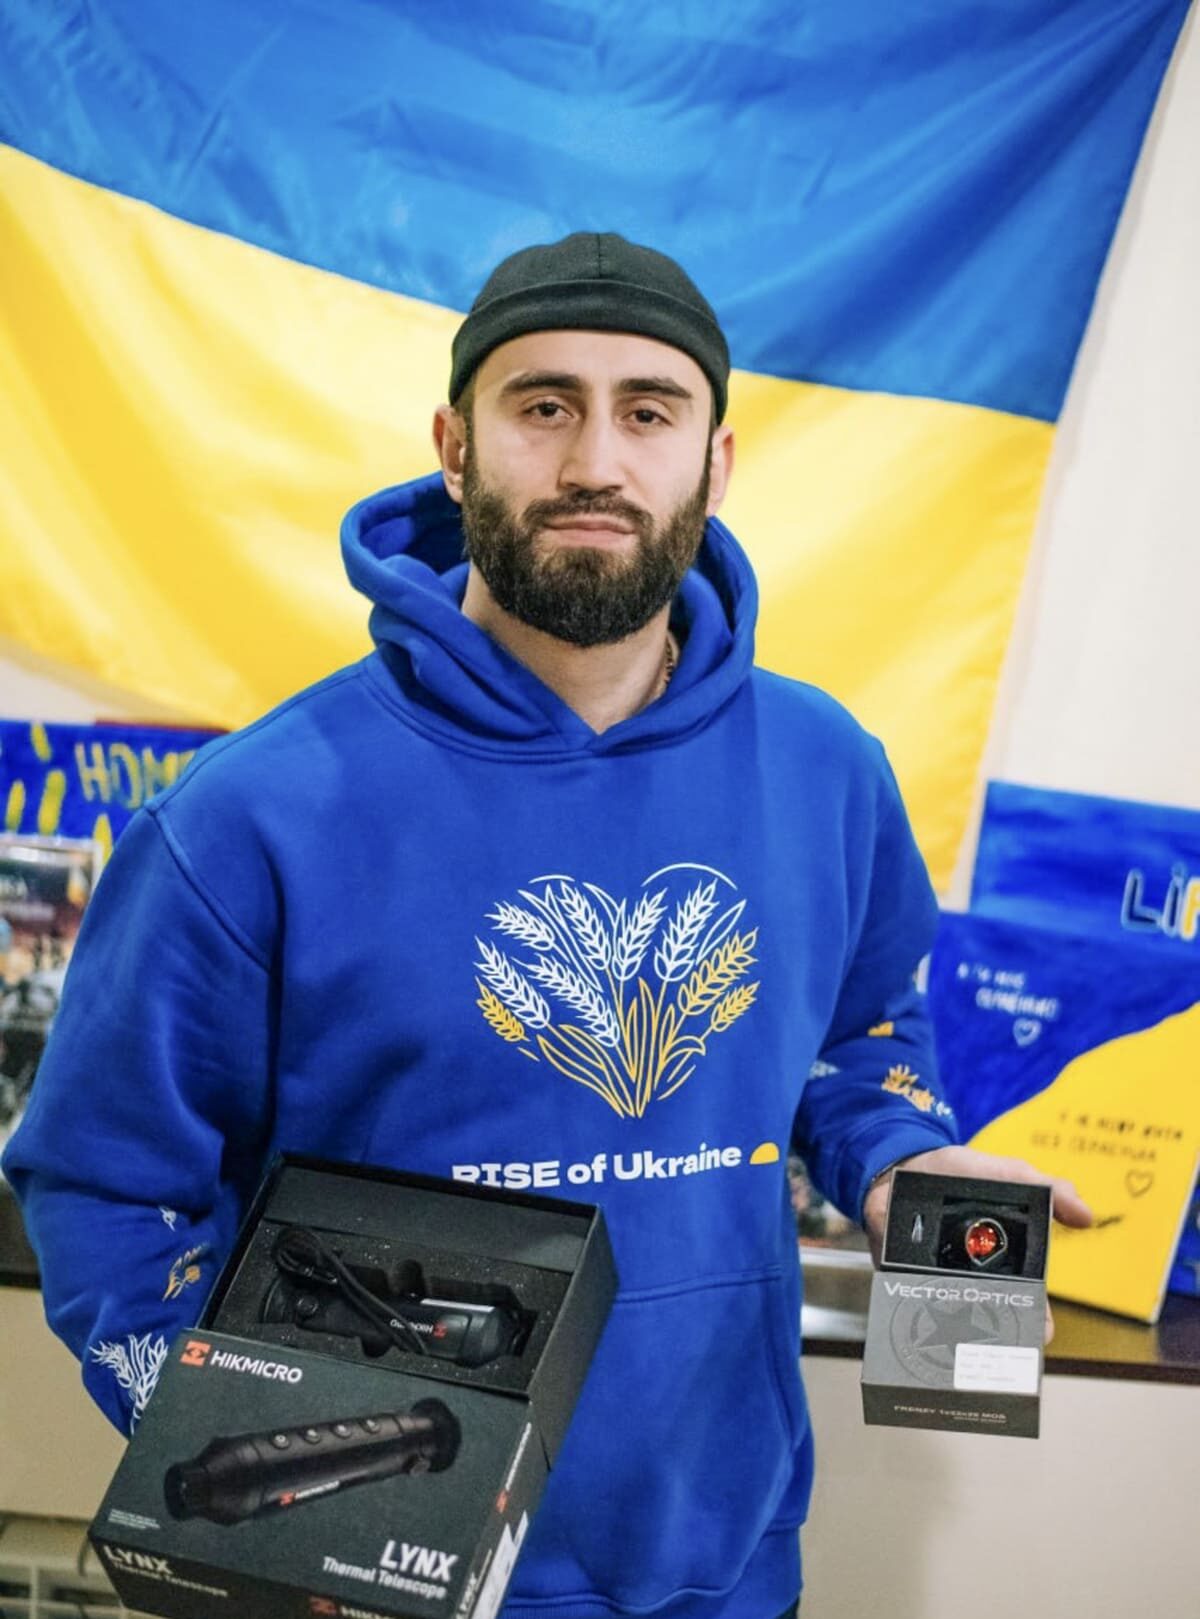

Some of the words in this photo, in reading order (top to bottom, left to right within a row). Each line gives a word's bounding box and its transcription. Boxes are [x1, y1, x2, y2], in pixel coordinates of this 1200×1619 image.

[567, 1154, 607, 1184] of
[614, 1143, 742, 1180] Ukraine
[884, 1281, 960, 1302] VECTOR
[963, 1287, 1035, 1307] OPTICS
[210, 1350, 303, 1384] HIKMICRO
[102, 1544, 174, 1576] LYNX
[322, 1555, 376, 1584] Thermal
[378, 1569, 448, 1600] Telescope
[380, 1540, 459, 1582] LYNX
